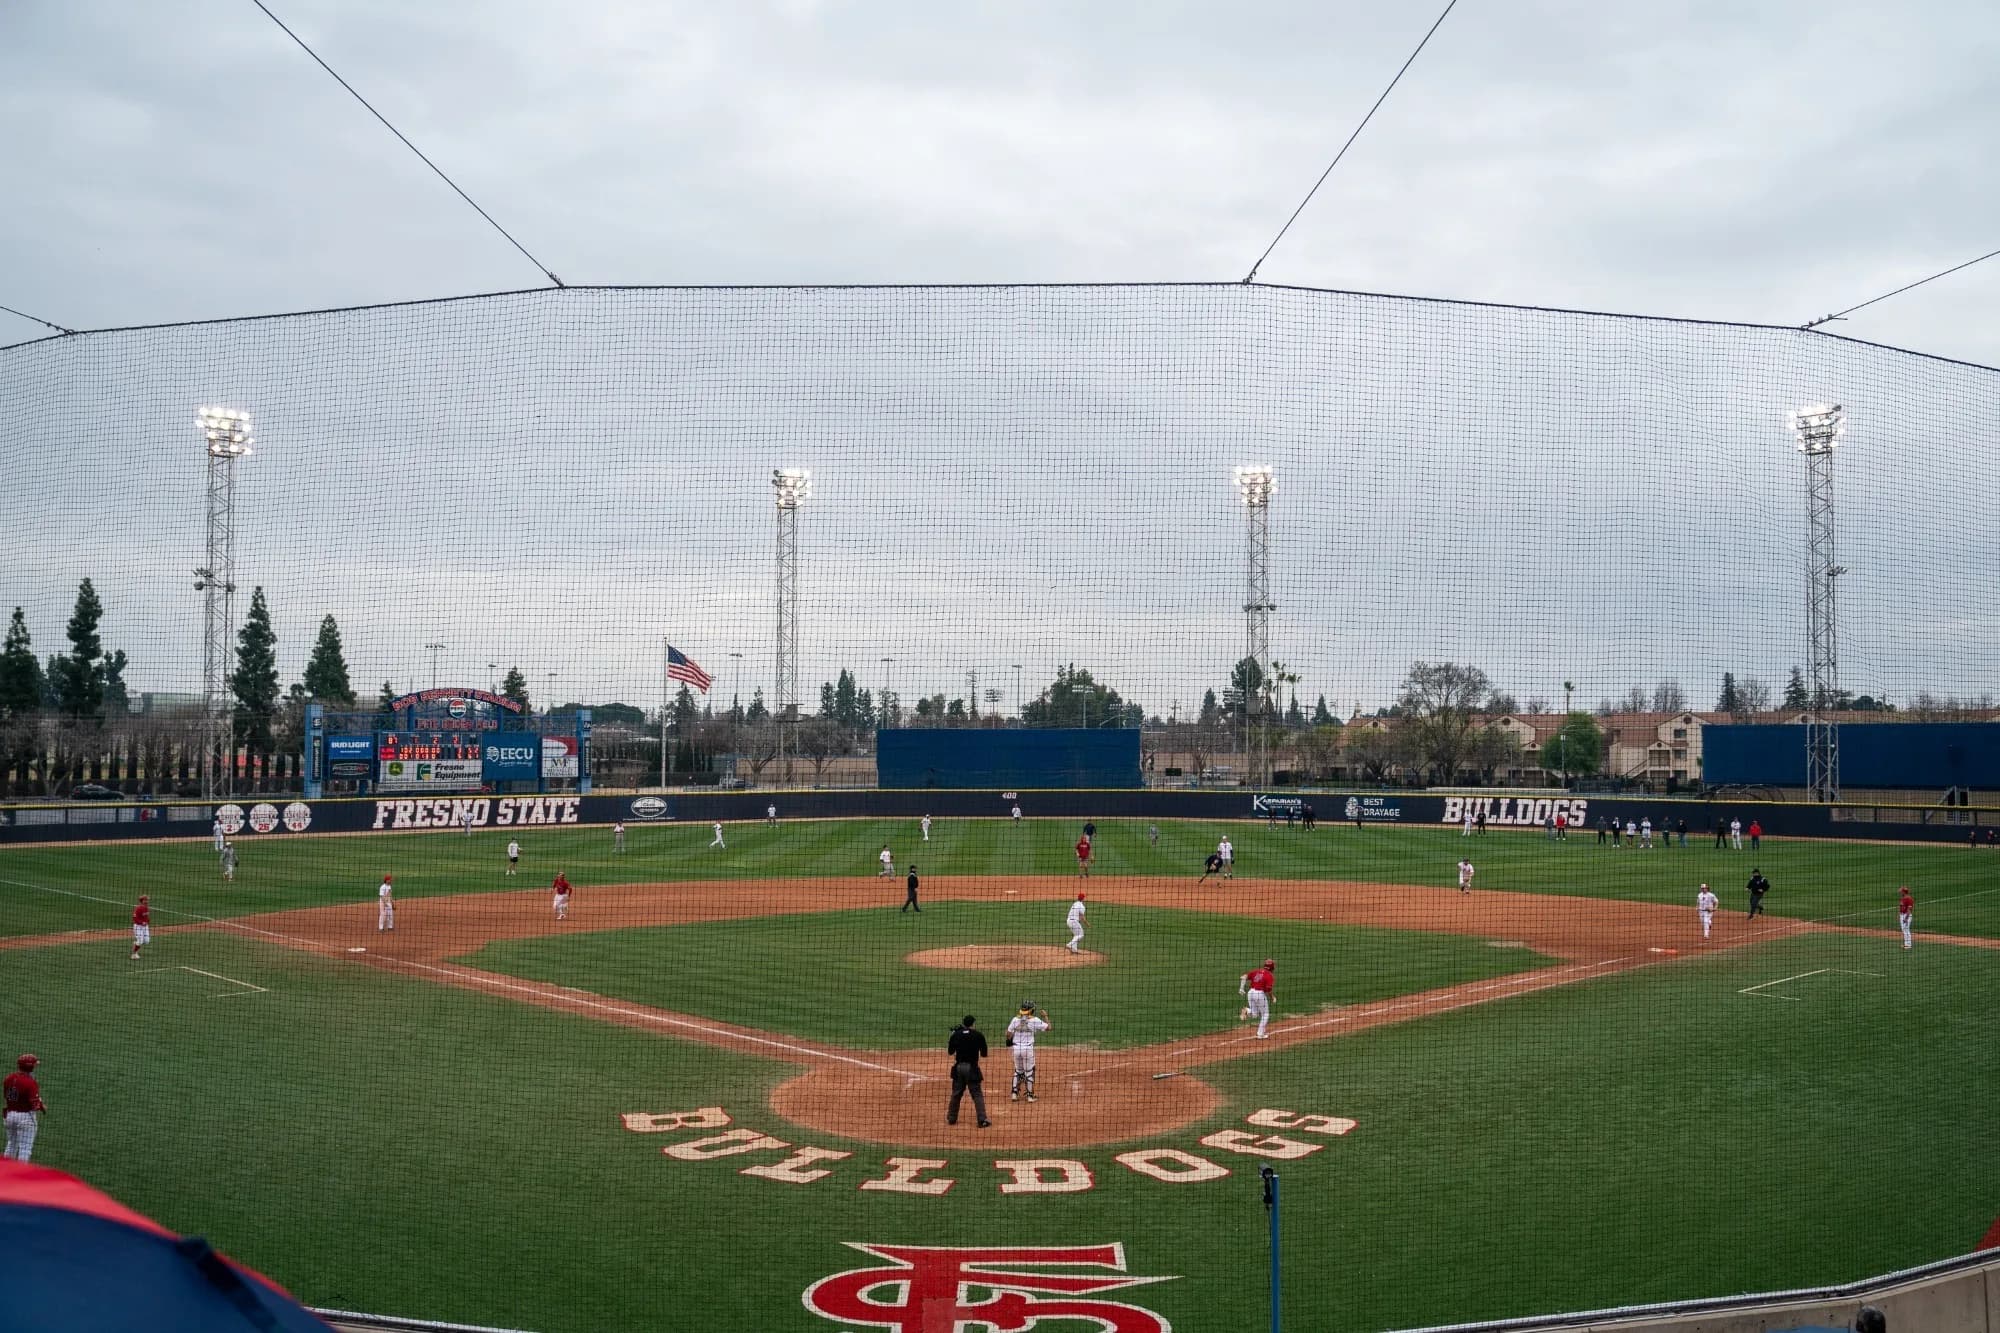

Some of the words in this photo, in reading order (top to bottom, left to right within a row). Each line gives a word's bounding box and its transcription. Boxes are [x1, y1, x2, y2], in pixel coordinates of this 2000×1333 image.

[500, 747, 534, 760] EECU
[434, 763, 465, 771] Fresno
[434, 771, 481, 781] Equipment
[1002, 791, 1017, 799] 400
[1363, 798, 1385, 806] BEST
[372, 798, 491, 829] FRESNO
[496, 797, 581, 825] STATE
[1363, 808, 1401, 817] DRAYAGE
[1442, 796, 1588, 827] BULLDOGS
[620, 1106, 1359, 1195] BULLDOGS
